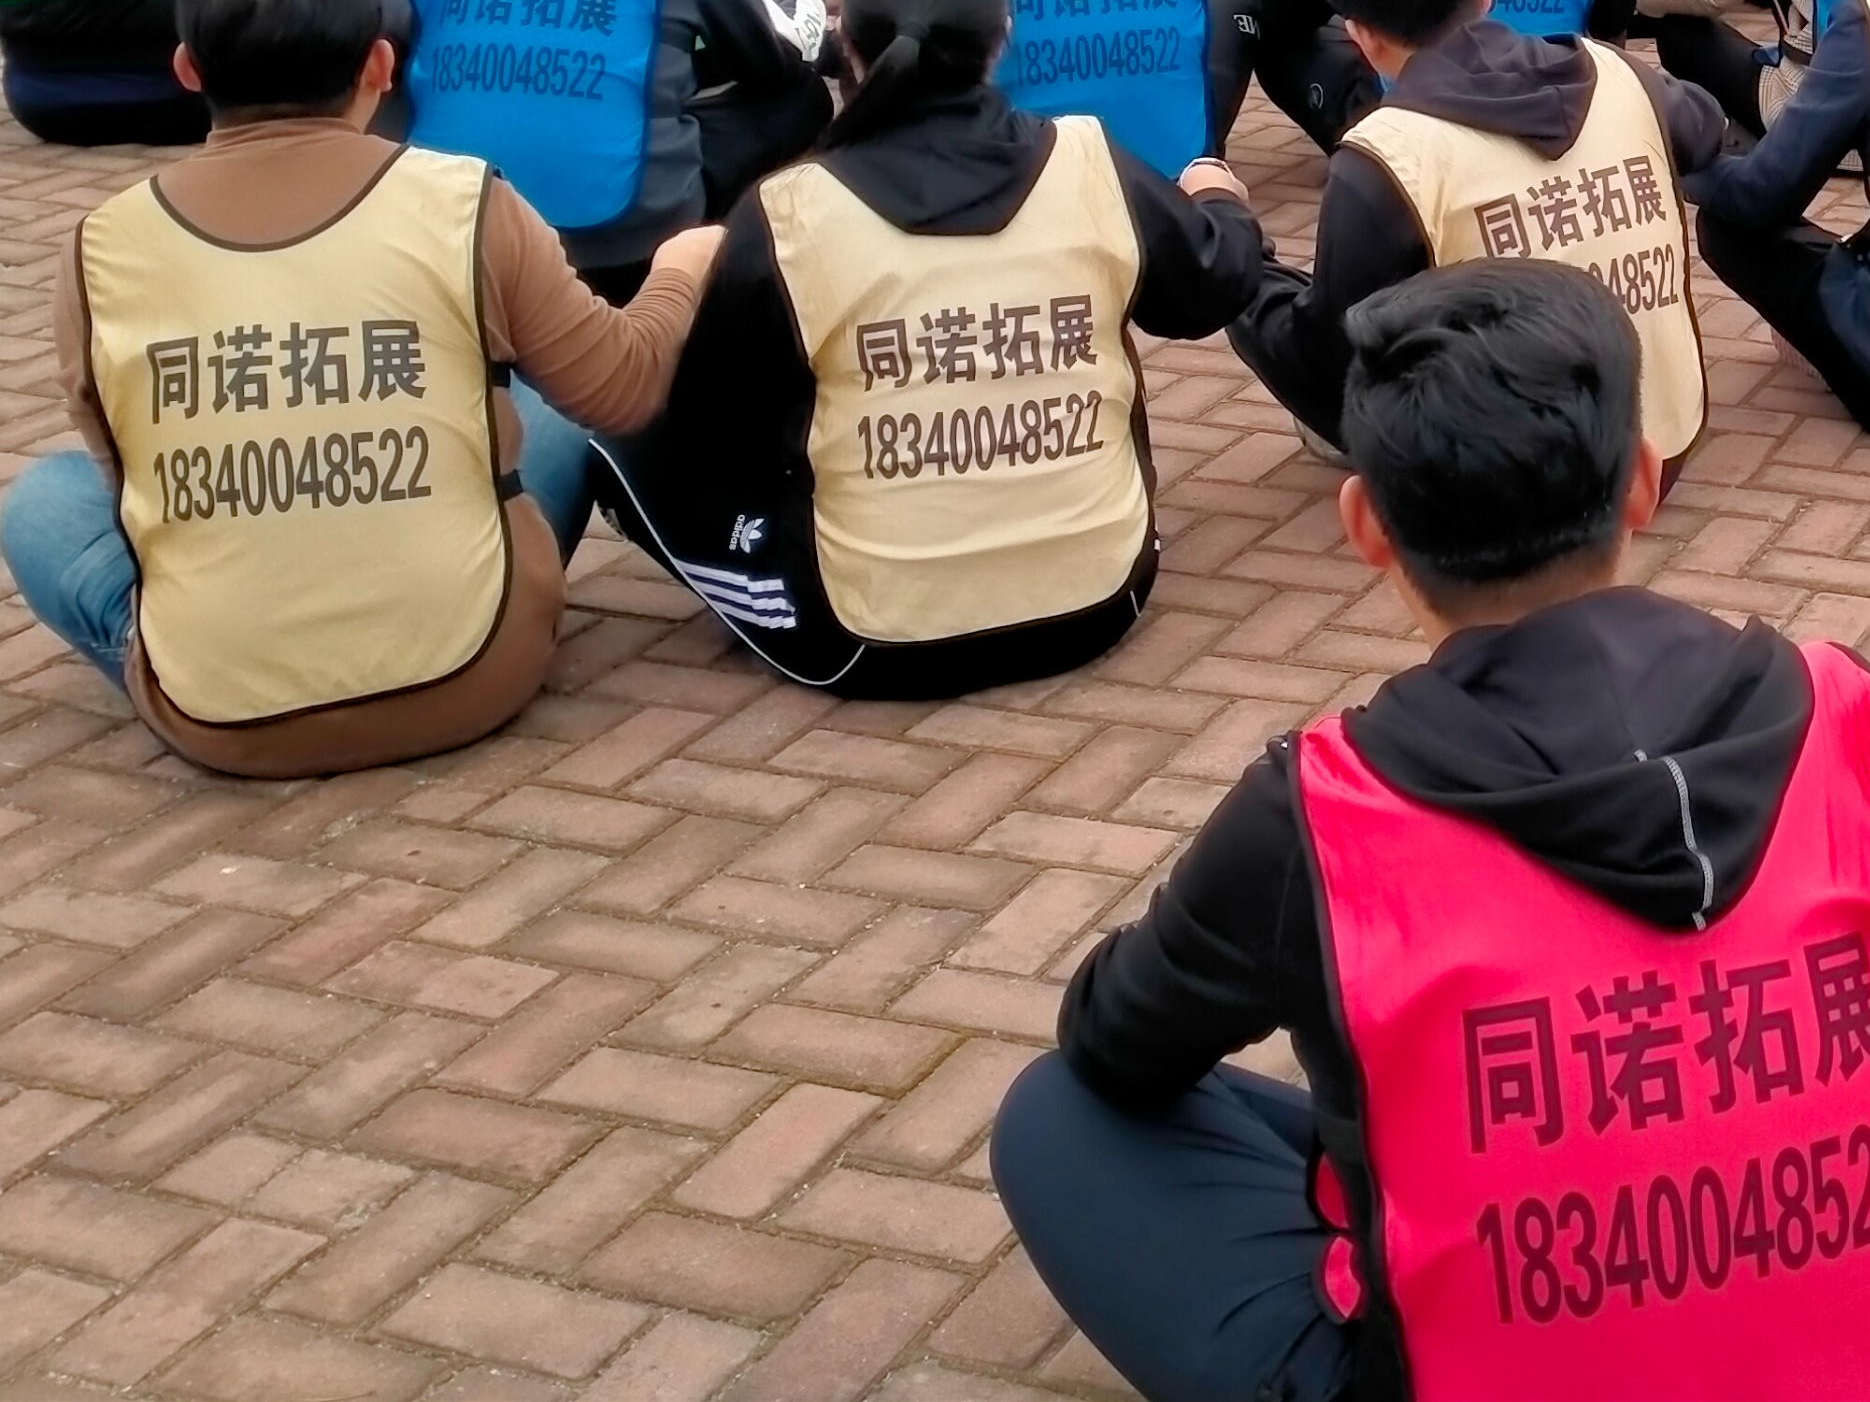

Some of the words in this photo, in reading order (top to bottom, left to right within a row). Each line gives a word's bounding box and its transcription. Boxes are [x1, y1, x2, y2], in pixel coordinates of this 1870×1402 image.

[432, 42, 606, 100] 18340048522
[1016, 26, 1180, 86] 18340048522
[1474, 154, 1667, 259] 同诺拓展
[146, 318, 428, 425] 同诺拓展
[855, 294, 1098, 392] 同诺拓展
[152, 424, 433, 524] 18340048522
[856, 389, 1104, 480] 18340048522
[729, 514, 746, 551] adidas
